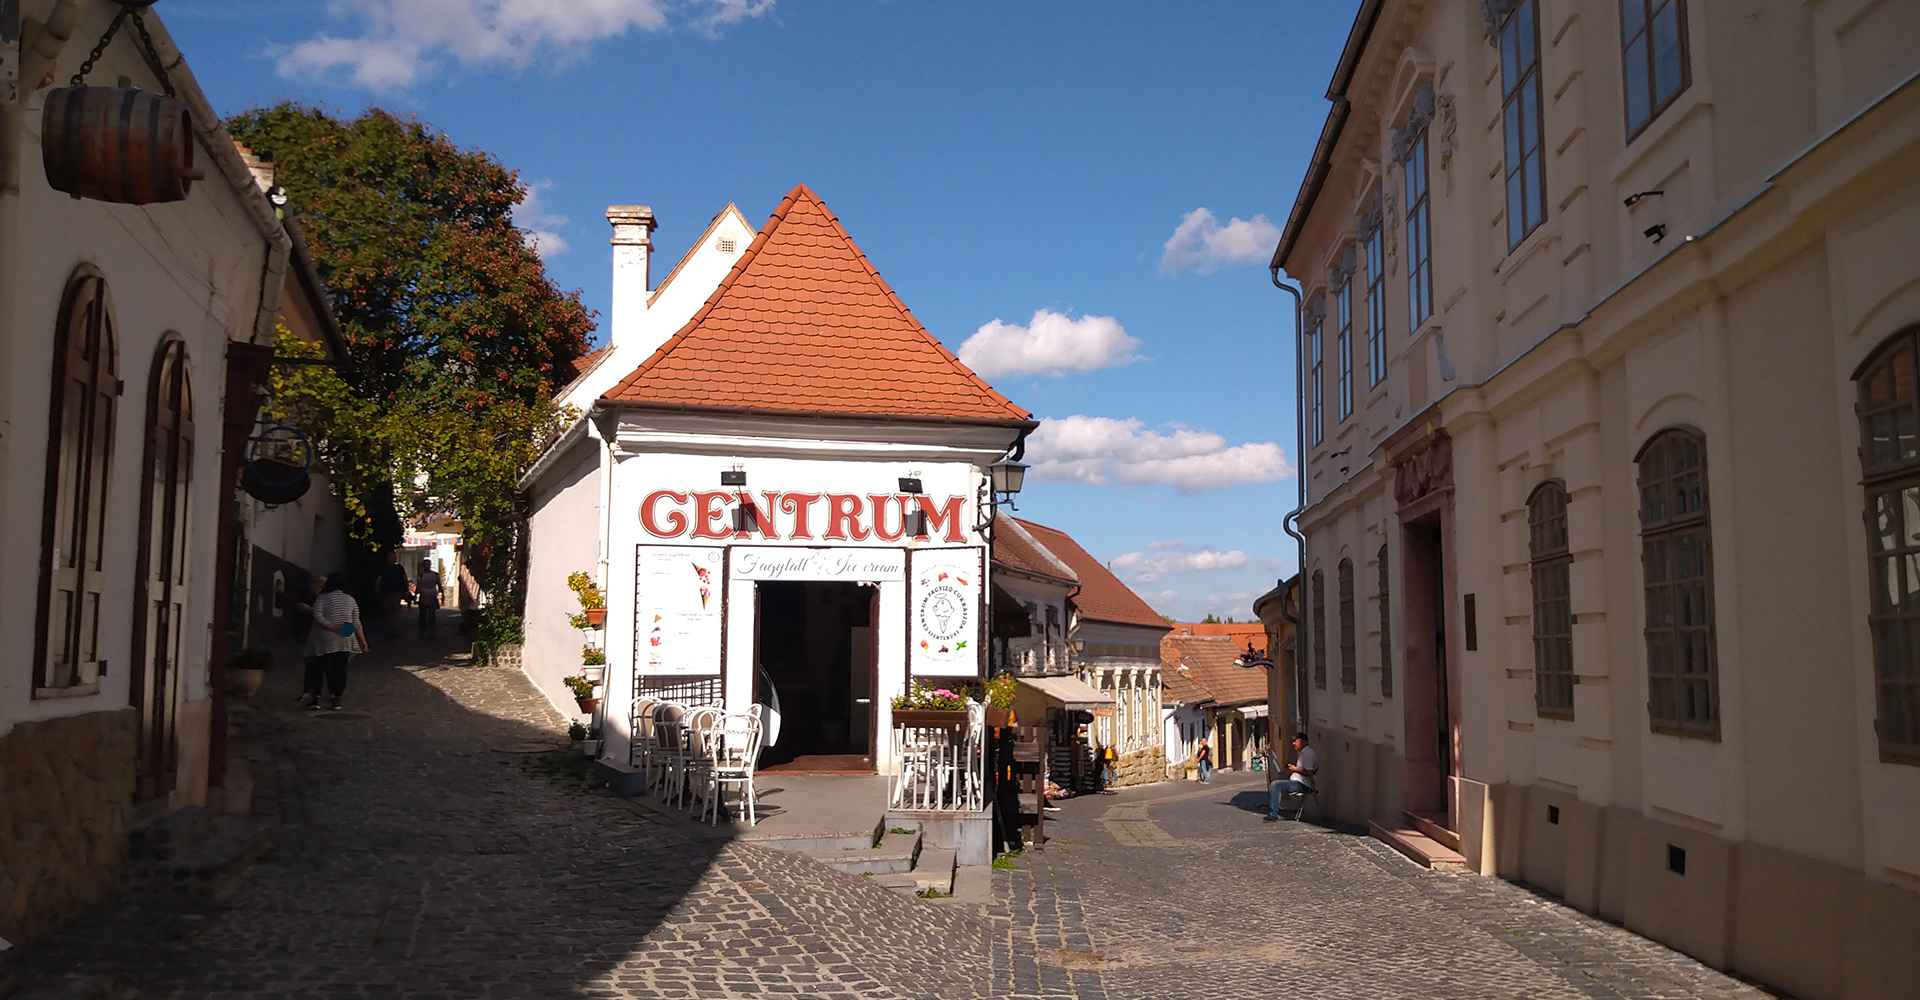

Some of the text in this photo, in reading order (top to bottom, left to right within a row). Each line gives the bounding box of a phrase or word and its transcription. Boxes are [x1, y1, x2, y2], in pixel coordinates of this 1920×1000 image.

[638, 490, 967, 543] CENTRUM
[834, 554, 857, 576] Ice
[863, 561, 899, 573] cream
[920, 597, 929, 631] CENTRUM
